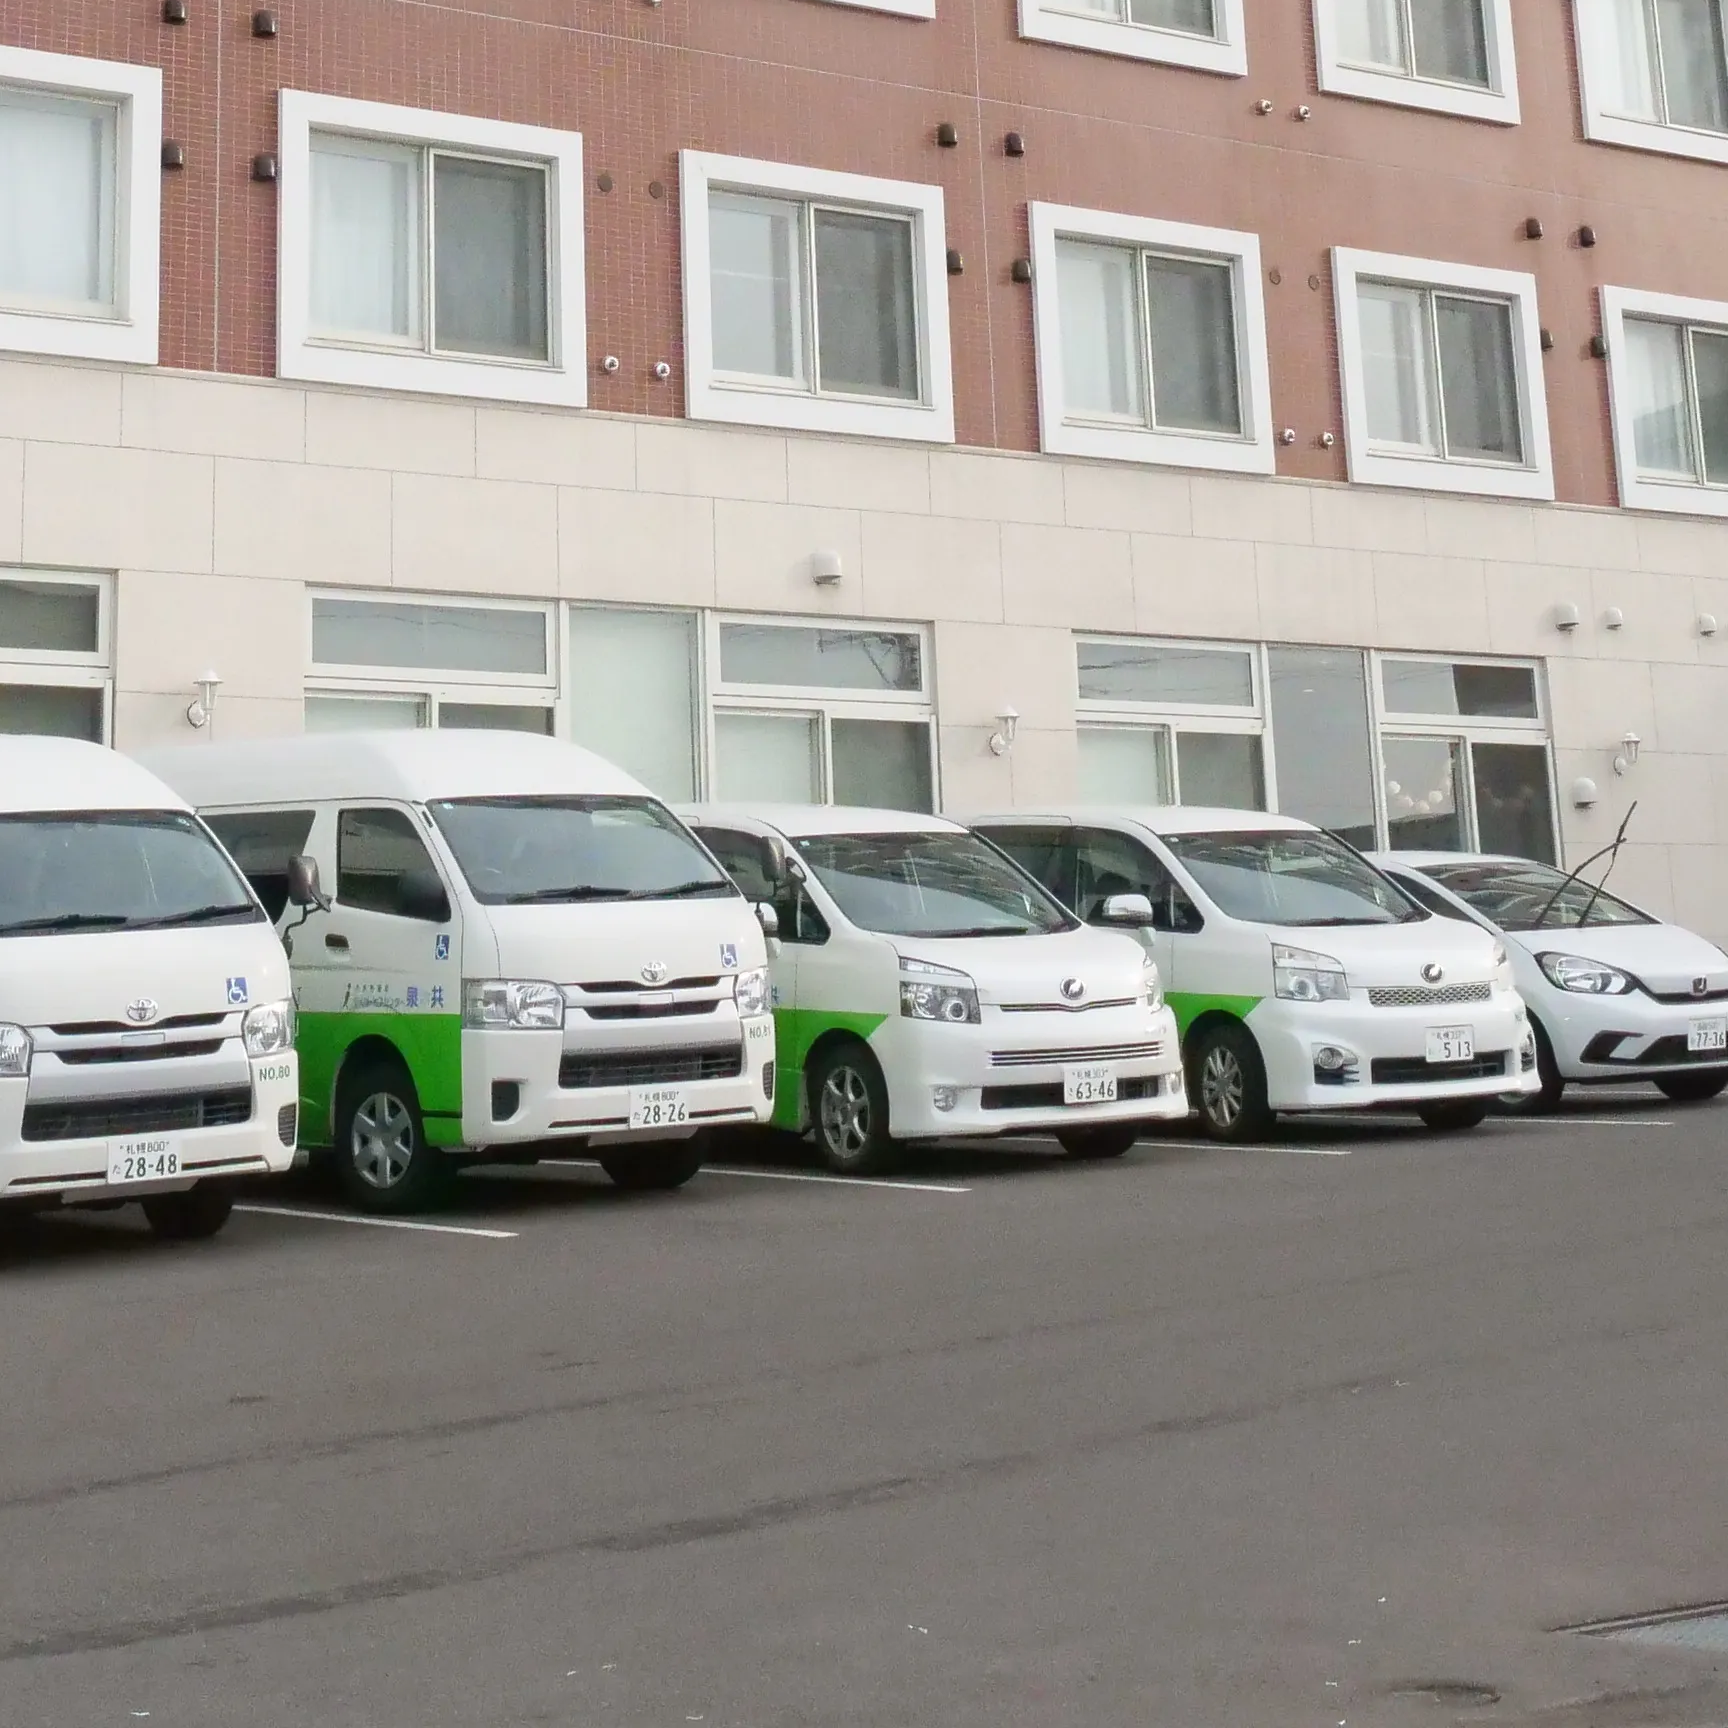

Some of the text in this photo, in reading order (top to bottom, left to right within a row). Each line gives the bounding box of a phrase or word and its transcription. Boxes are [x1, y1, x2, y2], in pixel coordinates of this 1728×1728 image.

[1075, 1080, 1114, 1100] 63-46
[643, 1103, 686, 1125] 28-26
[124, 1153, 178, 1179] 28-48
